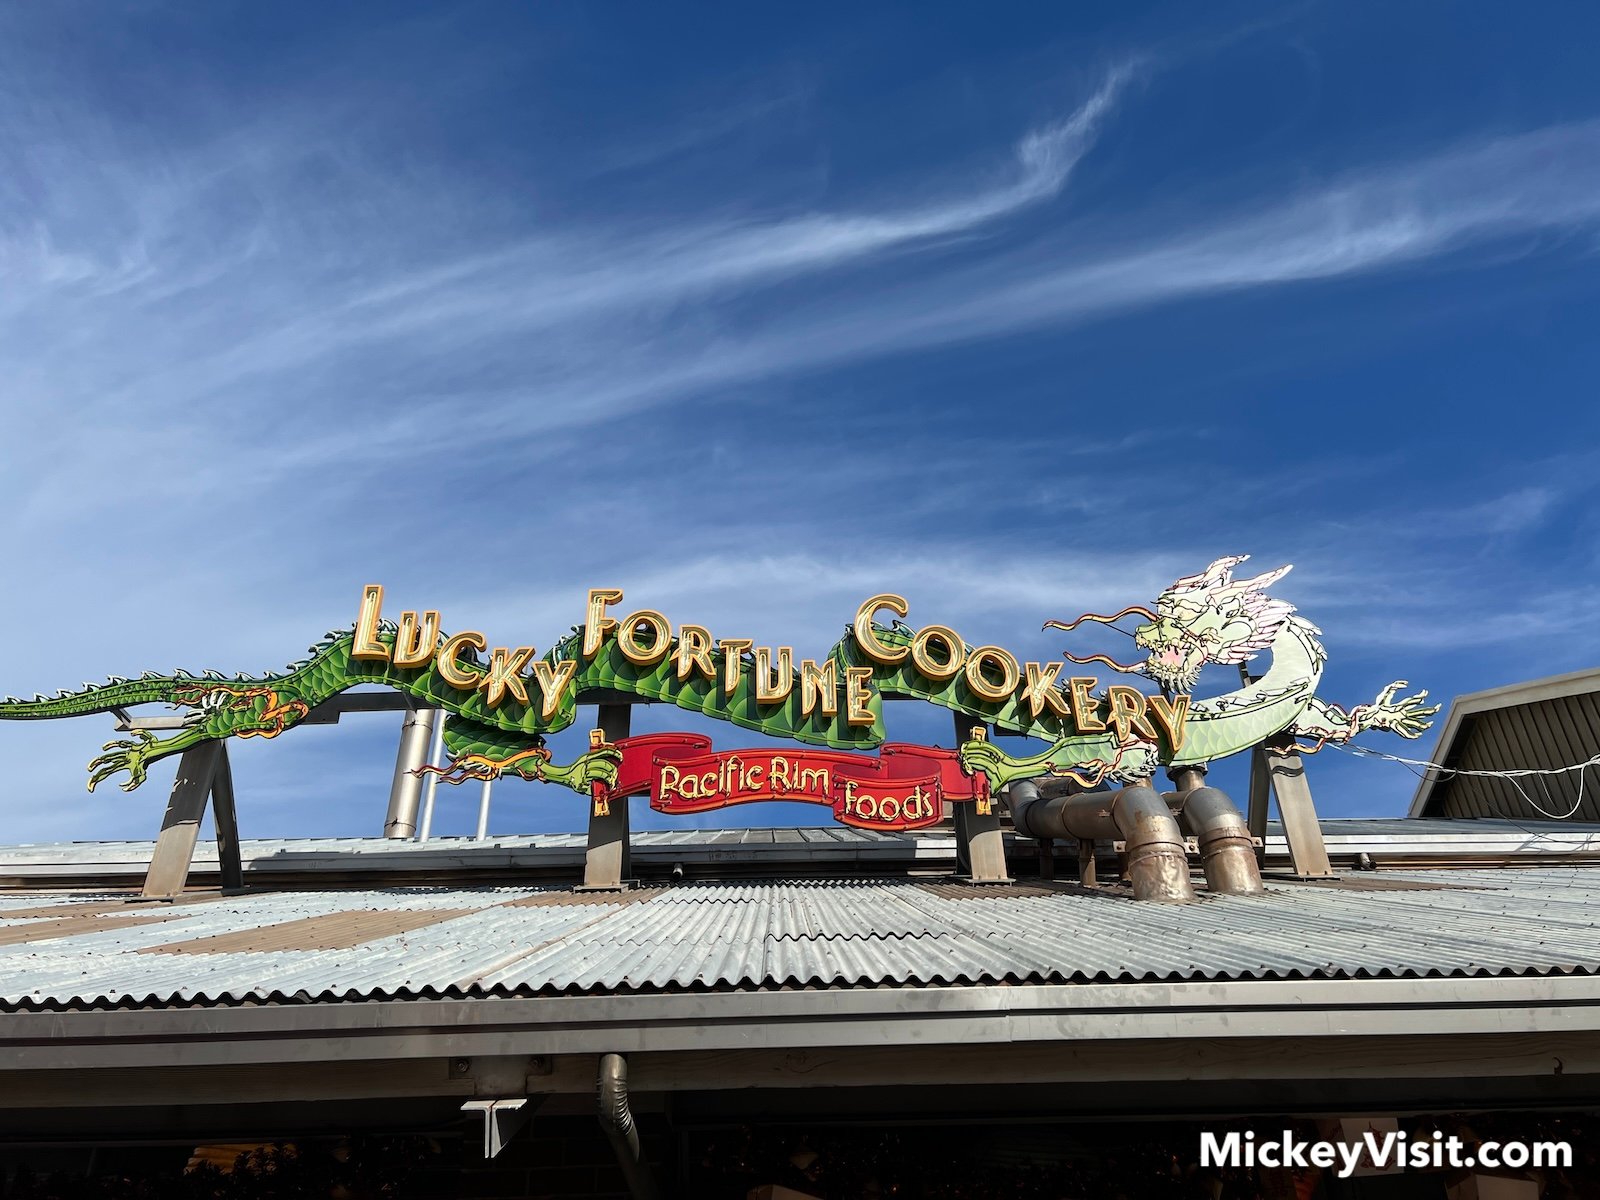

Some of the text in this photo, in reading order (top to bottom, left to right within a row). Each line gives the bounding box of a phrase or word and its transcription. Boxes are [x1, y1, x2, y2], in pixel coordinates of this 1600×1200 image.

[351, 585, 1191, 753] LUCKY FORTUNE COOKERY
[658, 755, 830, 801] Pacific Rim
